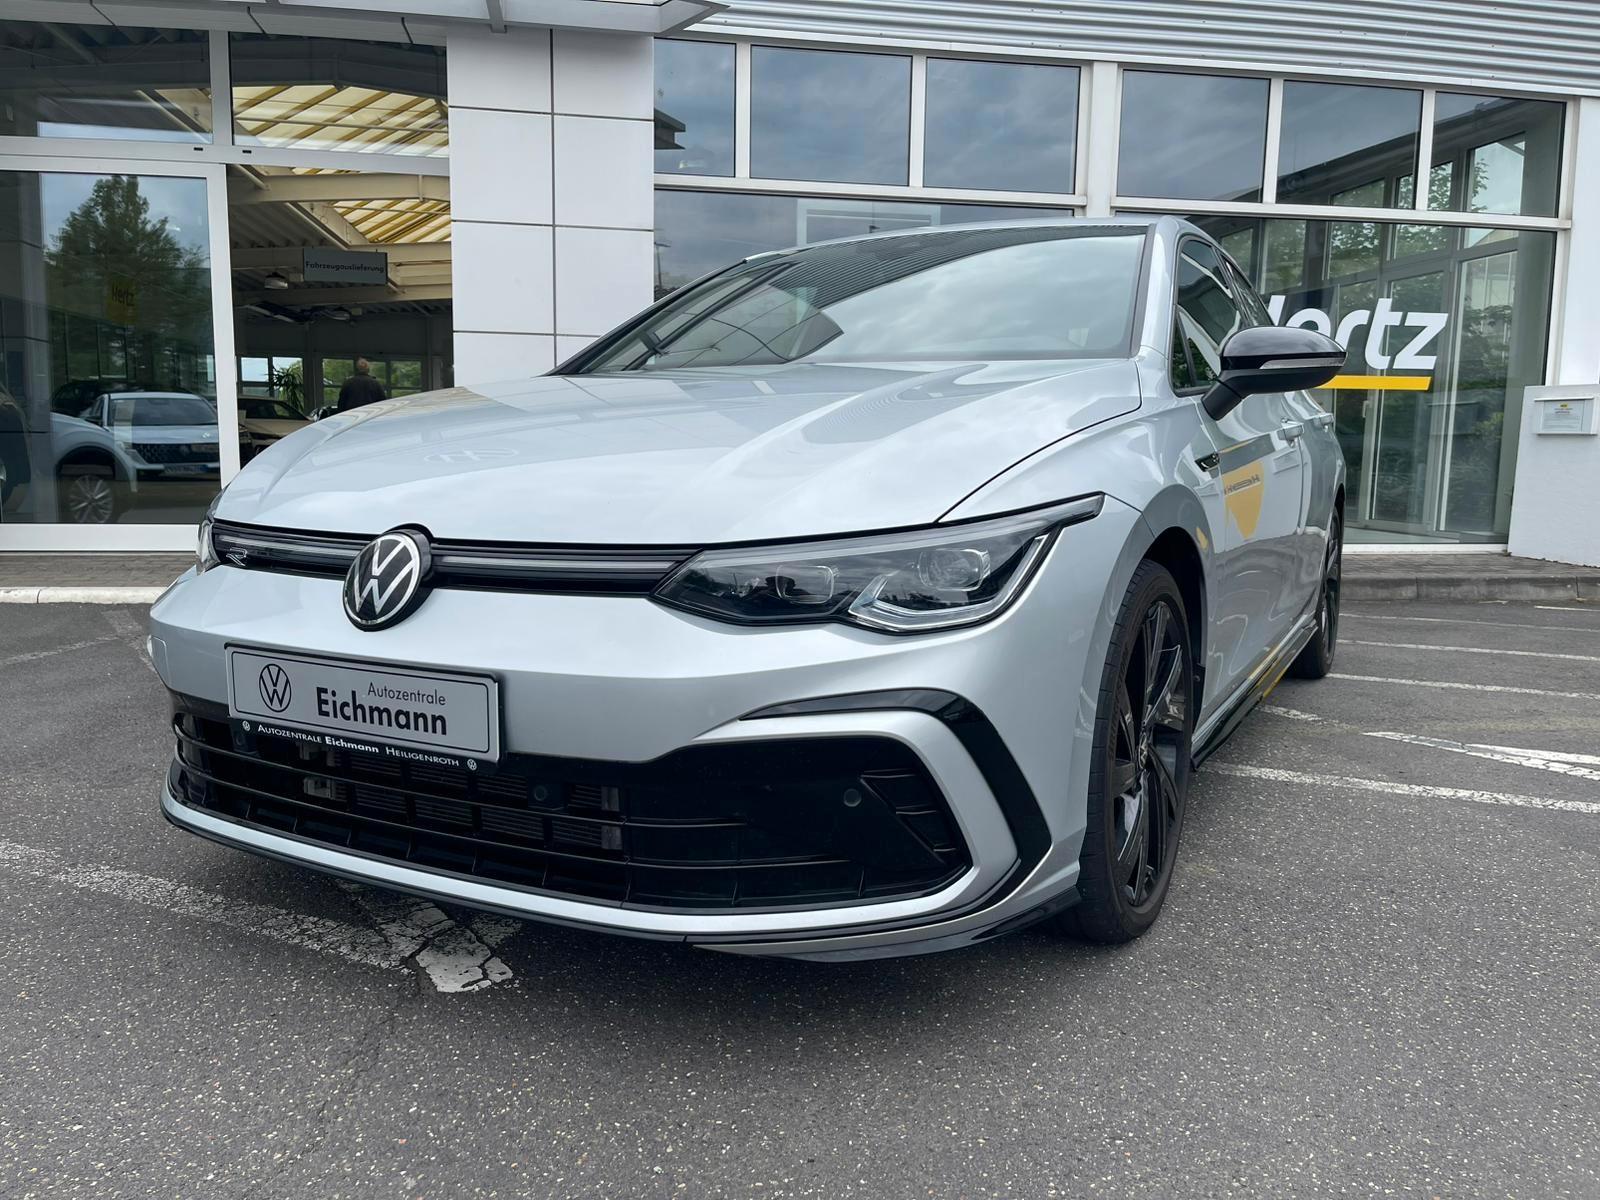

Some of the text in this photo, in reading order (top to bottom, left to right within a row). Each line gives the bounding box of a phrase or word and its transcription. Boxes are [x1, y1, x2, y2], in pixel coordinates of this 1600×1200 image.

[305, 261, 385, 273] Fahrzeugauslieferung
[1267, 294, 1449, 370] rtz
[316, 686, 447, 735] Eichmann
[367, 681, 446, 706] Autozentrale
[257, 724, 460, 767] AUTOZENTRALE Eichmann HEILIGENROTH
